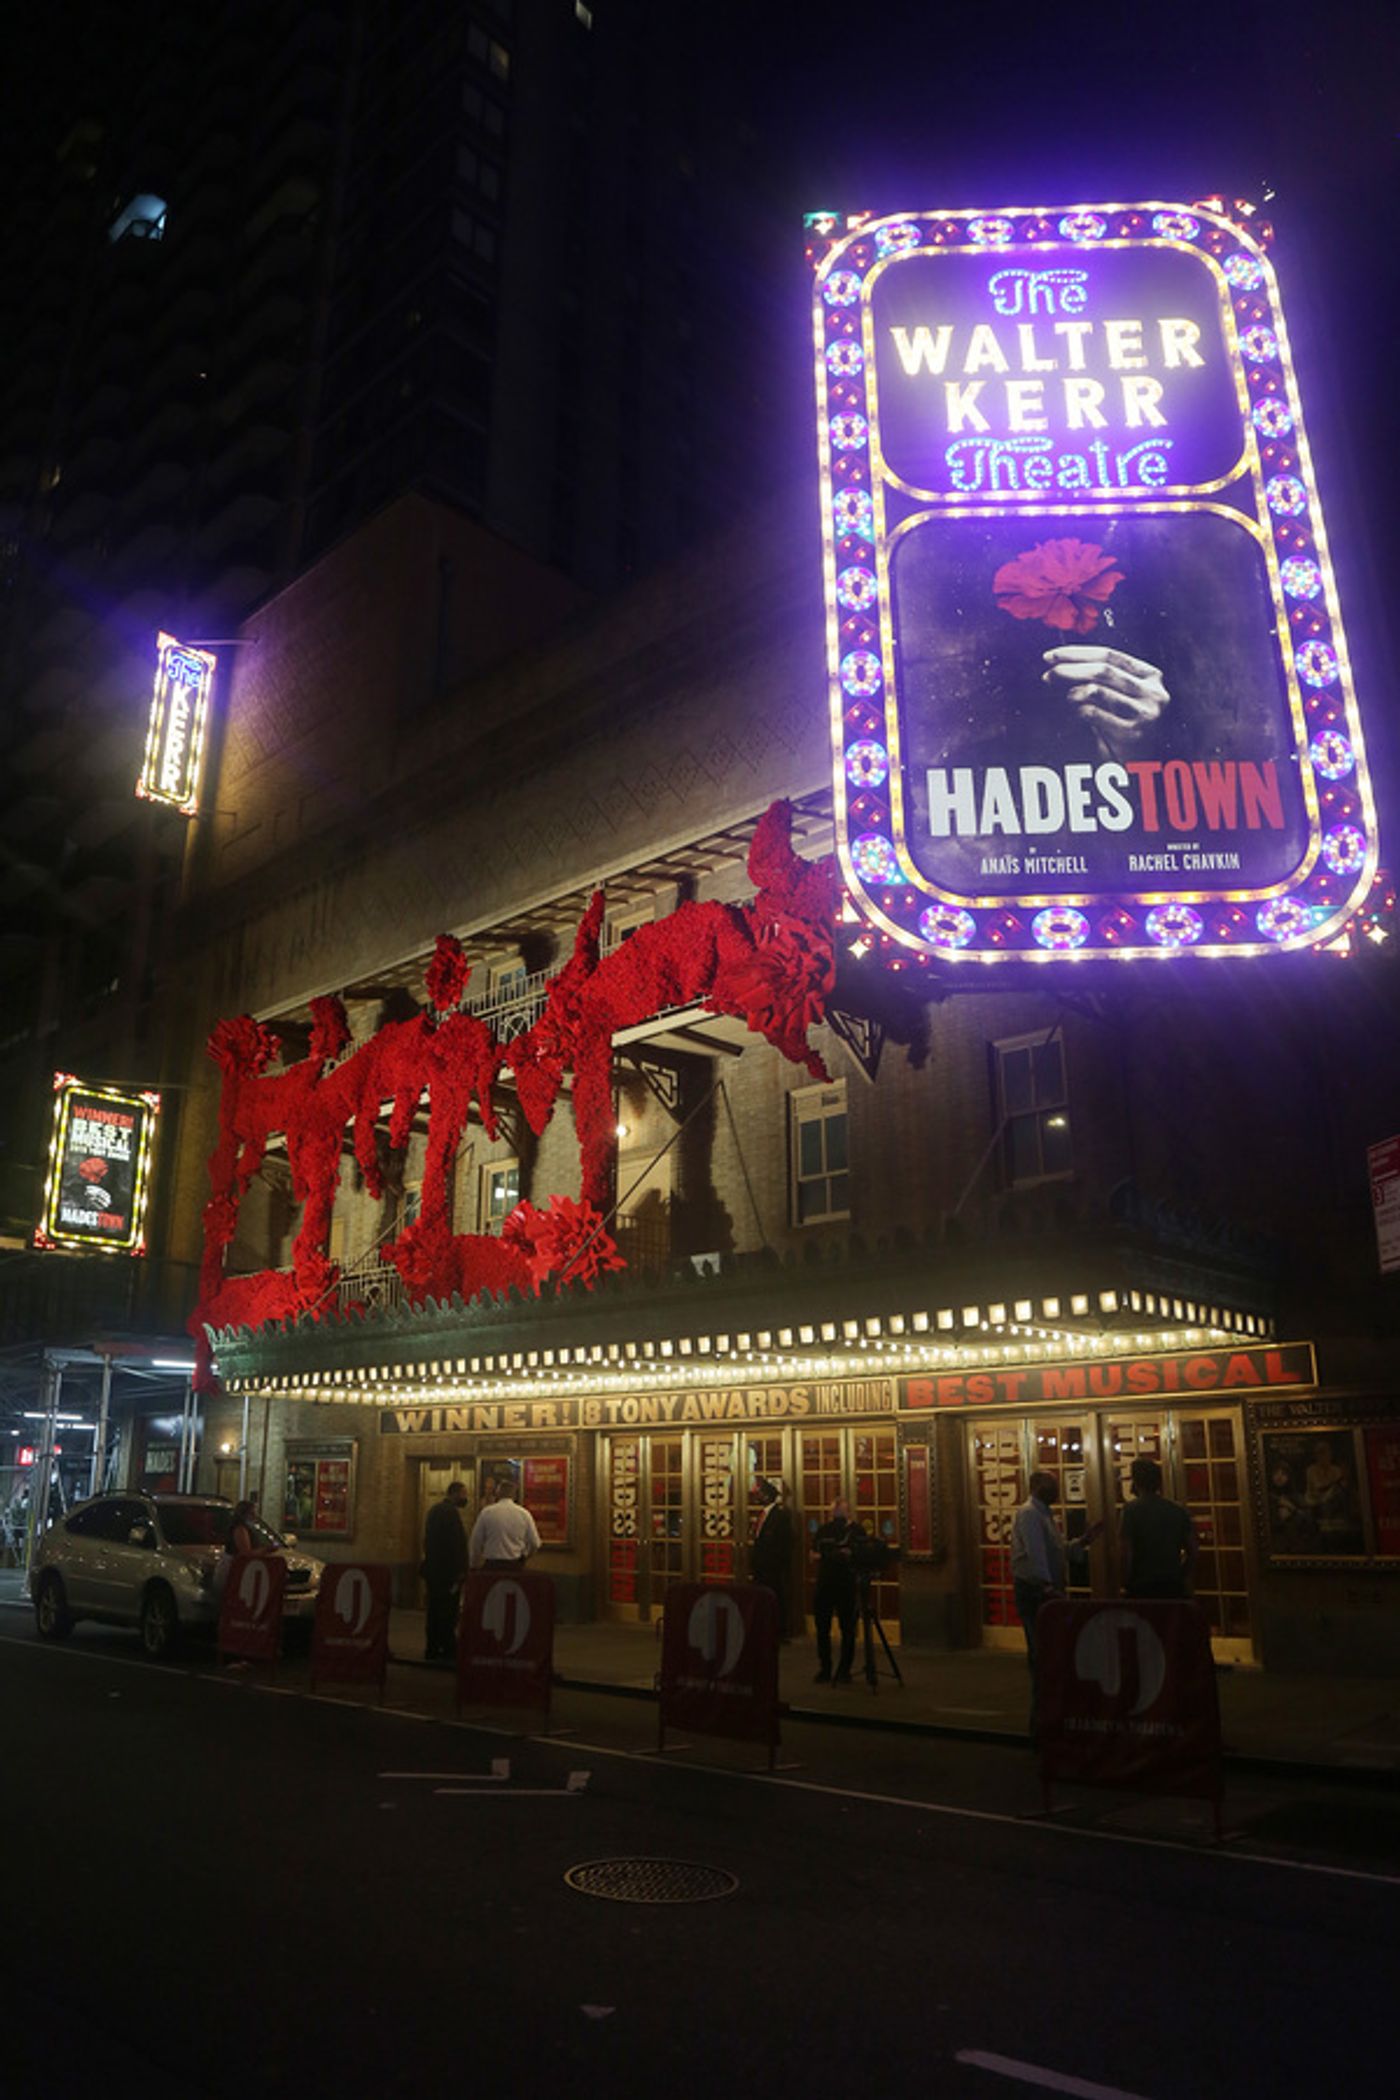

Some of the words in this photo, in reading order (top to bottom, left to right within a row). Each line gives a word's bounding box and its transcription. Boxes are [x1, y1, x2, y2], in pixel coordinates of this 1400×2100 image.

[988, 269, 1089, 315] The
[890, 318, 1206, 377] WALTER
[944, 375, 1169, 433] KERR
[944, 436, 1174, 492] Theatre
[160, 682, 191, 793] KERR
[926, 760, 1285, 837] HADESTOWN
[1024, 856, 1088, 874] MITCHELL
[1129, 854, 1179, 871] RACHEL
[1183, 852, 1240, 870] CHAVKIN
[71, 1118, 132, 1140] BEST
[395, 1402, 571, 1432] WINNER!
[584, 1400, 599, 1425] 8
[606, 1395, 679, 1424] TONY
[681, 1385, 809, 1421] AWARDS
[815, 1379, 892, 1414] INCLUDING
[906, 1372, 1028, 1409] BEST
[1040, 1351, 1299, 1400] MUSICAL
